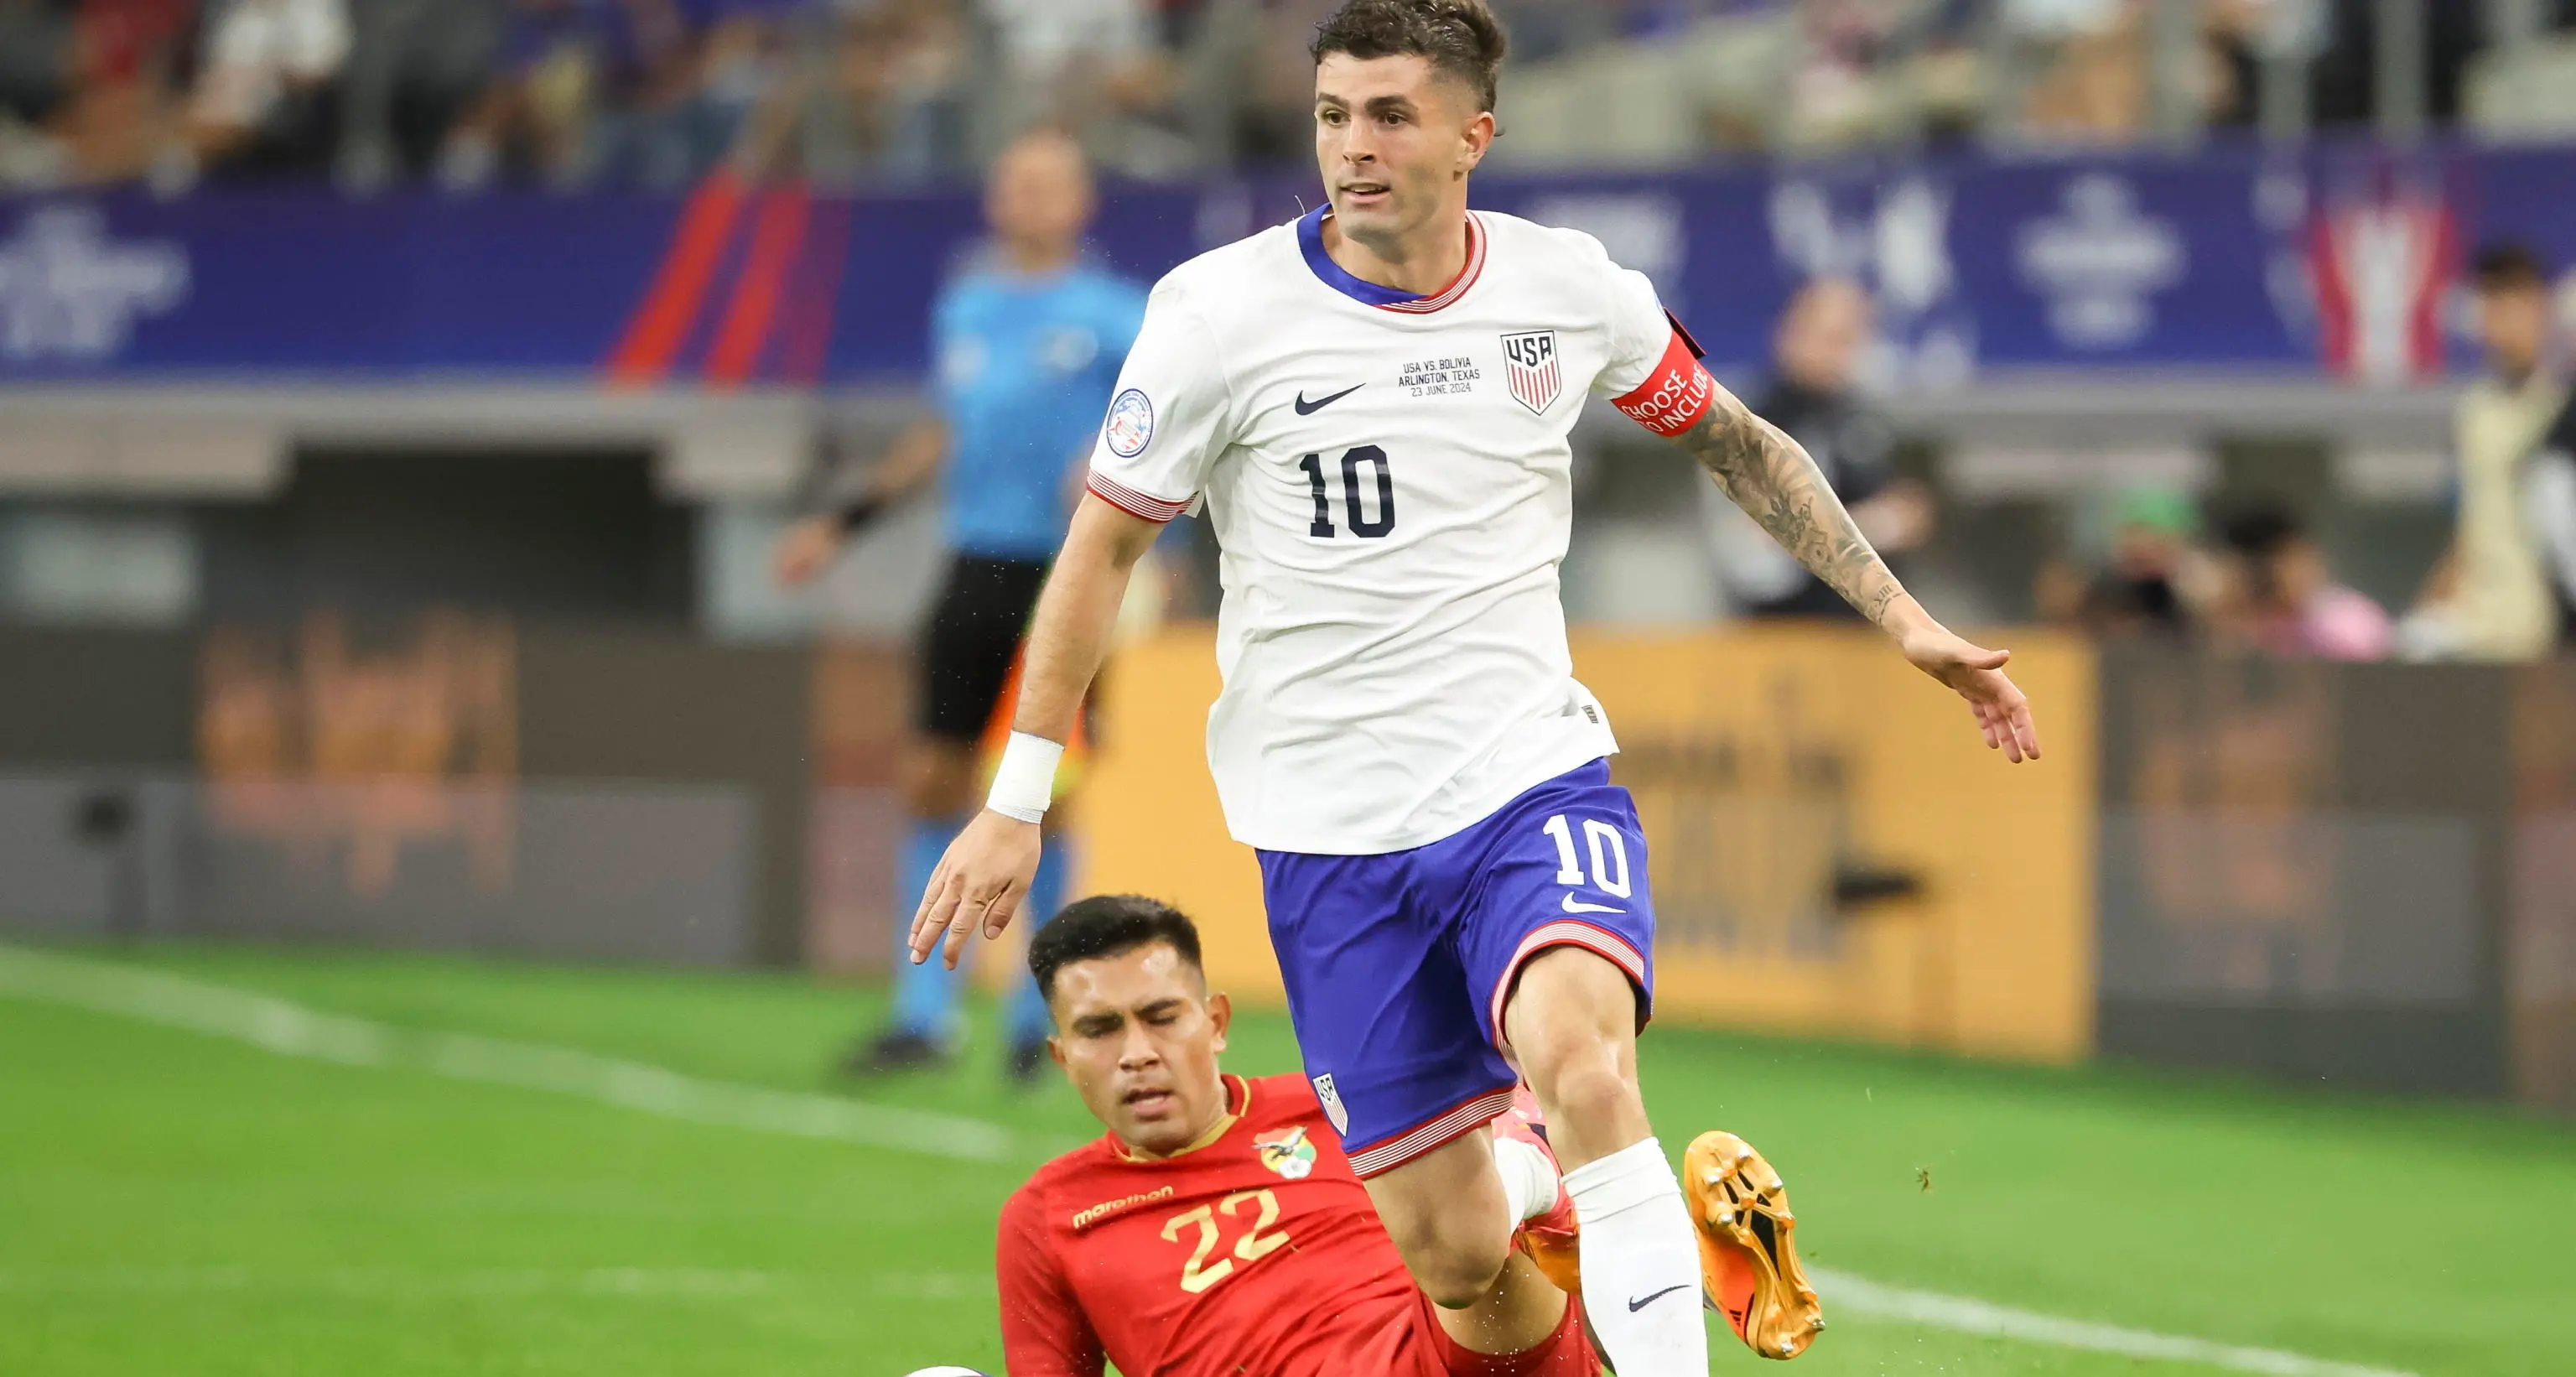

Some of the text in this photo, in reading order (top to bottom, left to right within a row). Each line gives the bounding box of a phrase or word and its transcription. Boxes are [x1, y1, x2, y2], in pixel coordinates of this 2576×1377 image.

[1404, 357, 1471, 373] USA VS. BOLIVIA
[1506, 336, 1551, 367] USA
[1411, 382, 1472, 397] 23 JUNE 2024
[1452, 369, 1480, 381] TEXAS
[1621, 369, 1688, 418] CHOOSE
[1659, 363, 1708, 429] INCLUDE
[1299, 444, 1395, 538] 10
[1542, 814, 1632, 899] 10
[1072, 1185, 1174, 1229] marathon
[1161, 1188, 1291, 1293] 22
